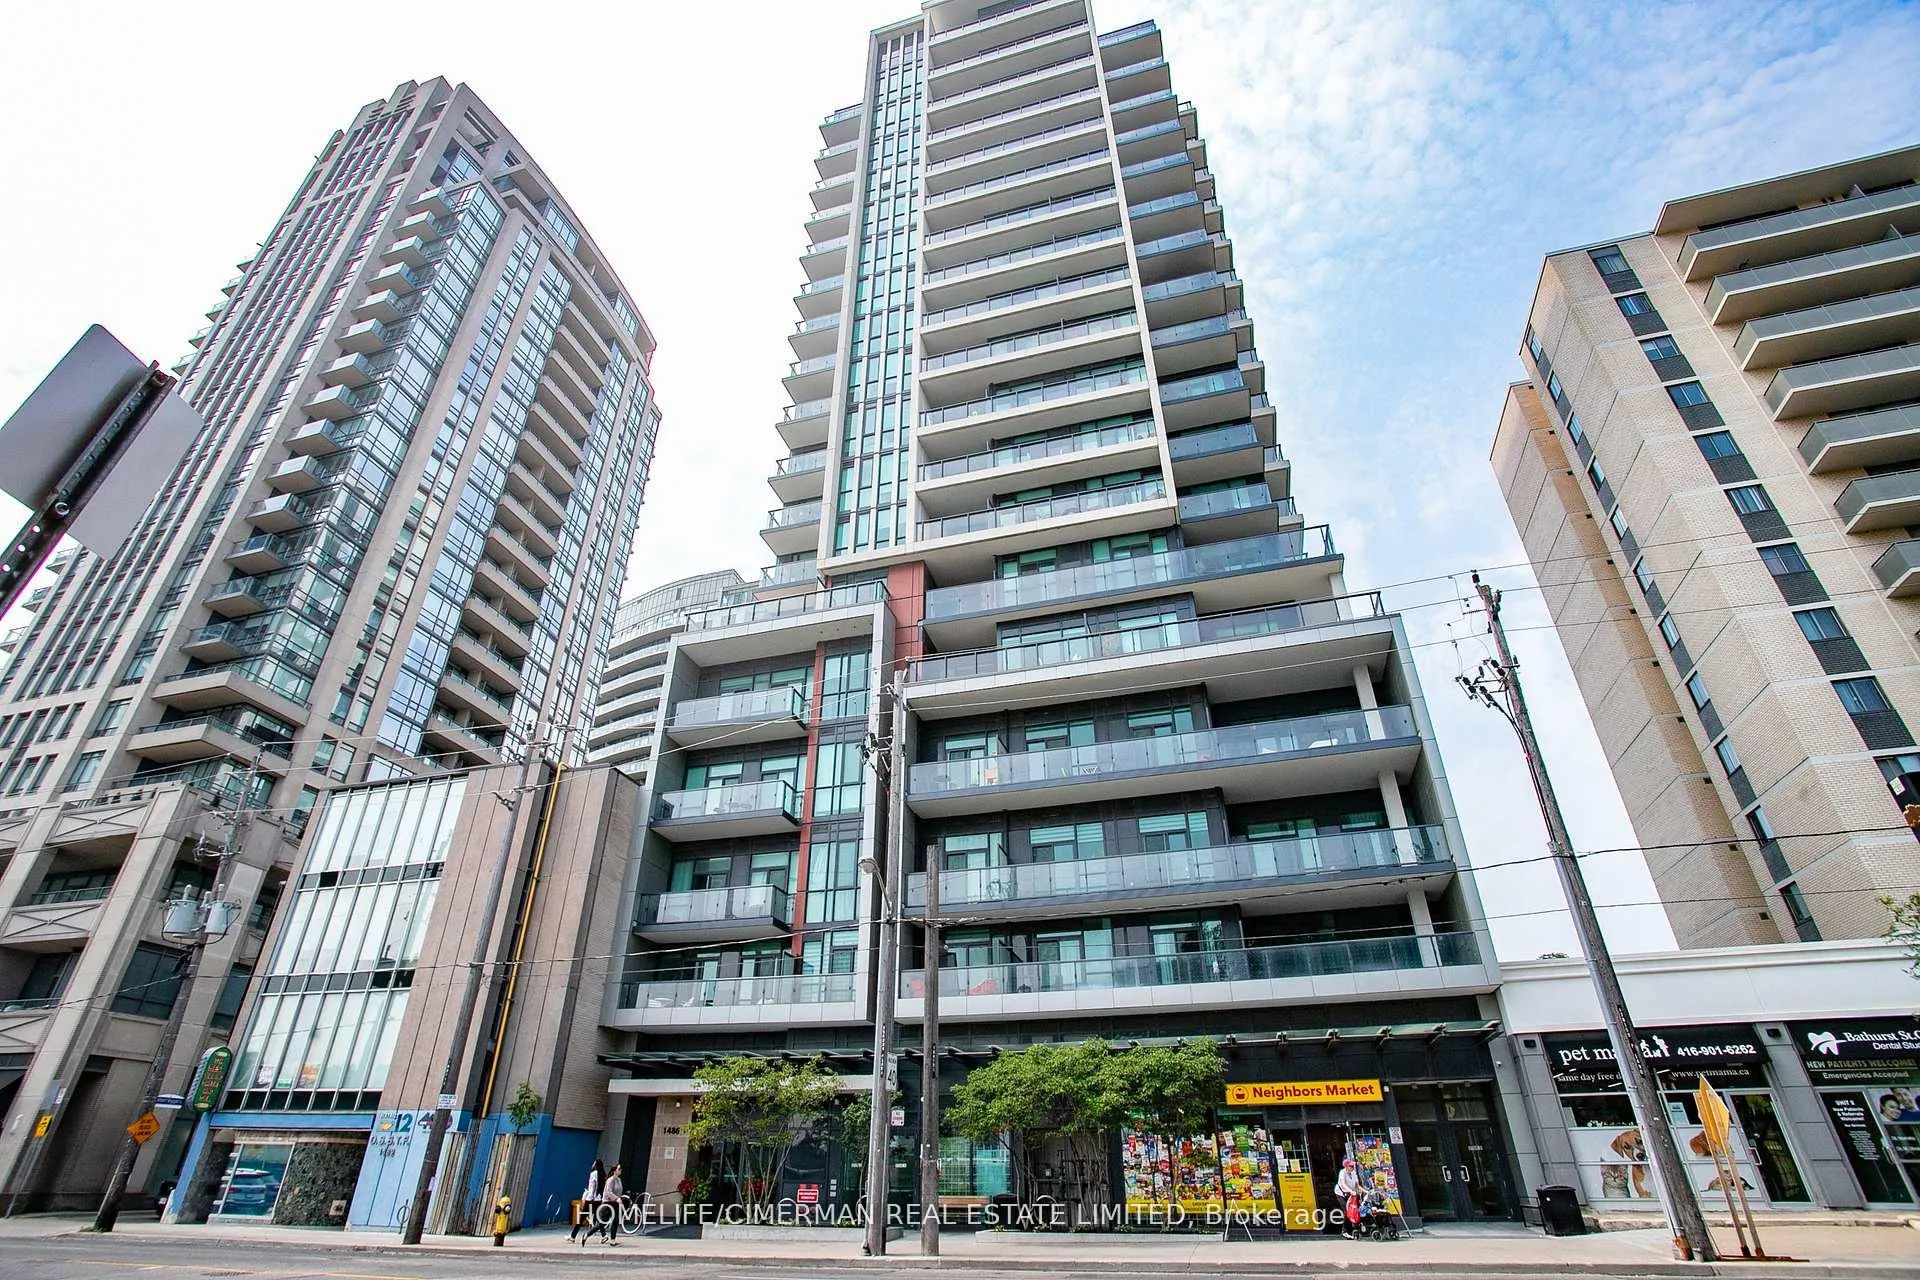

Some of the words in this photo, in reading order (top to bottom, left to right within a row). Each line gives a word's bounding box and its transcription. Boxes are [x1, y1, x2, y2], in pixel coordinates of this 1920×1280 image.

[1843, 1031, 1896, 1042] Bathurst
[1677, 1044, 1756, 1058] 416-901-6262
[1872, 1041, 1901, 1051] Dental
[1558, 1047, 1590, 1066] pet
[1806, 1061, 1826, 1069] NEW
[1828, 1060, 1868, 1069] PATIENTS
[887, 1069, 897, 1087] 40
[1557, 1074, 1579, 1083] same
[1581, 1073, 1596, 1084] day
[1597, 1072, 1616, 1082] free
[1823, 1072, 1872, 1080] Emergencies
[1873, 1071, 1910, 1079] Accepted
[1252, 1087, 1322, 1100] Neighbors
[1325, 1084, 1375, 1096] Market
[395, 1113, 413, 1132] 12
[663, 1127, 681, 1135] 1486
